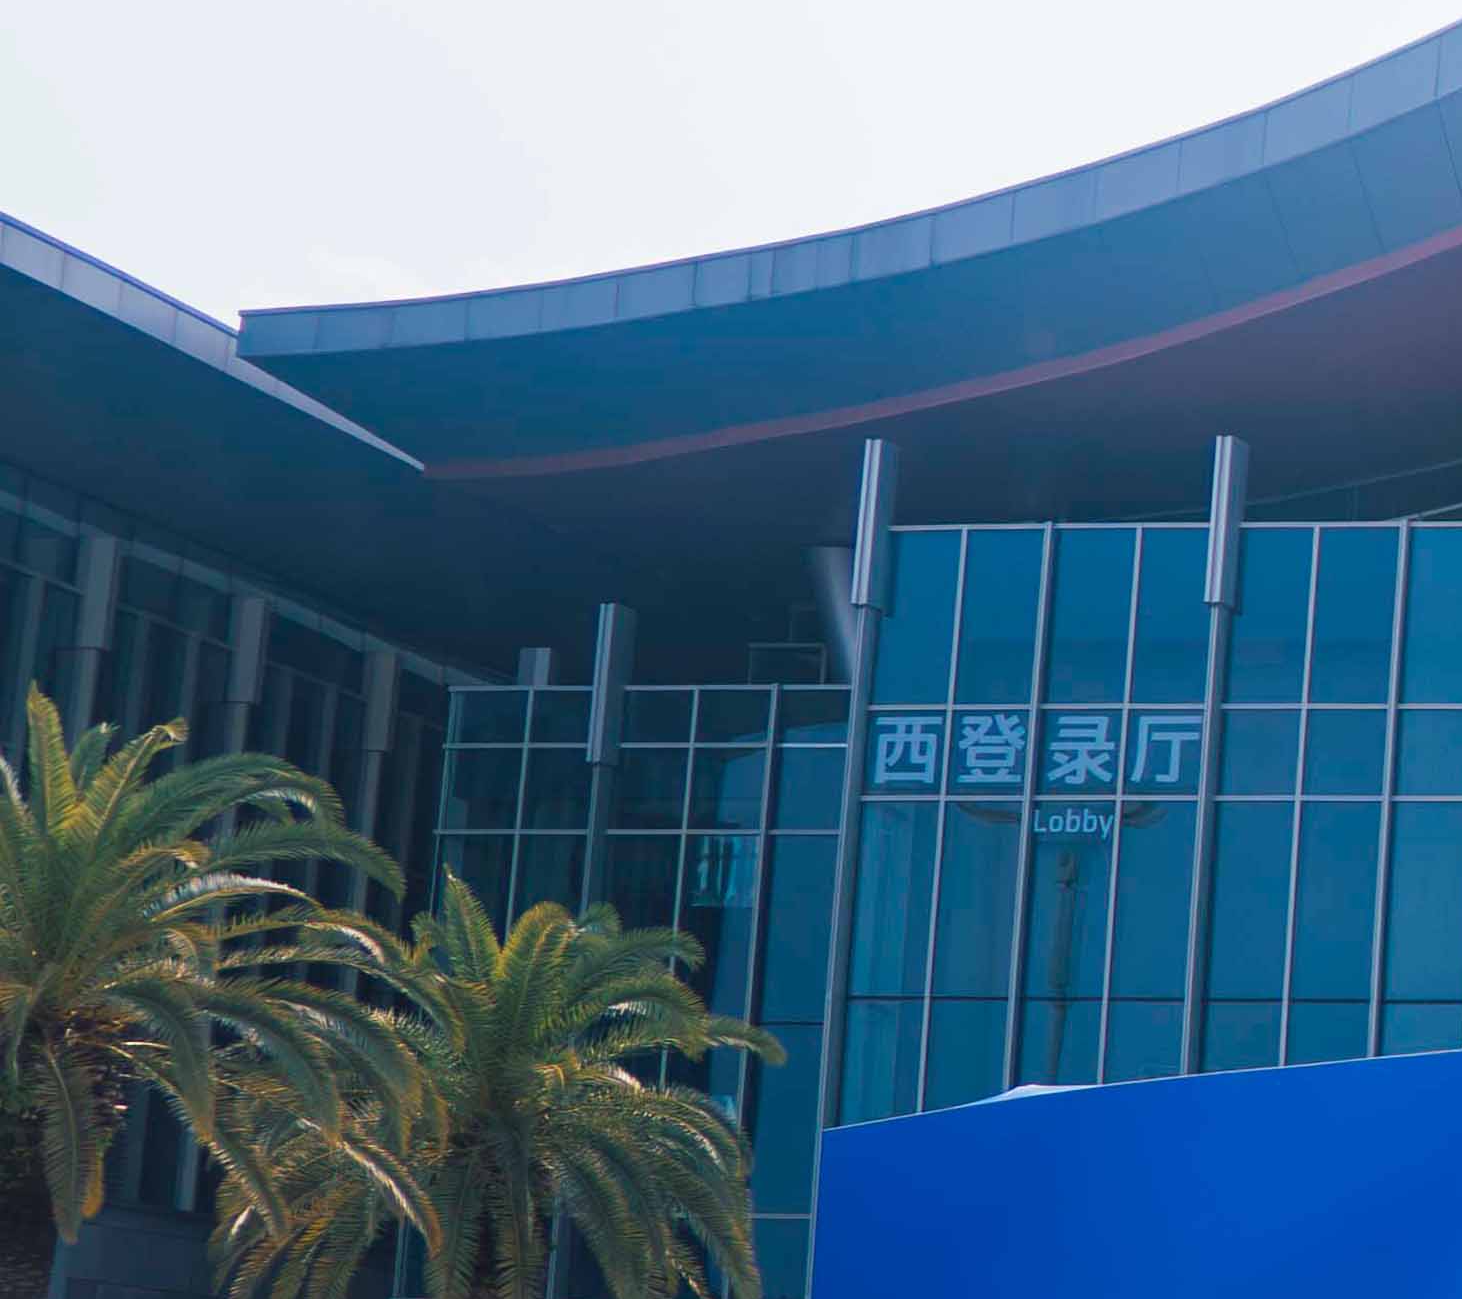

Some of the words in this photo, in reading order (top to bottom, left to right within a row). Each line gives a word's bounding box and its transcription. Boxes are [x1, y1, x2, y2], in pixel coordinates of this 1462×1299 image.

[873, 714, 1203, 785] 西登录厅
[1033, 809, 1115, 840] Lobby
